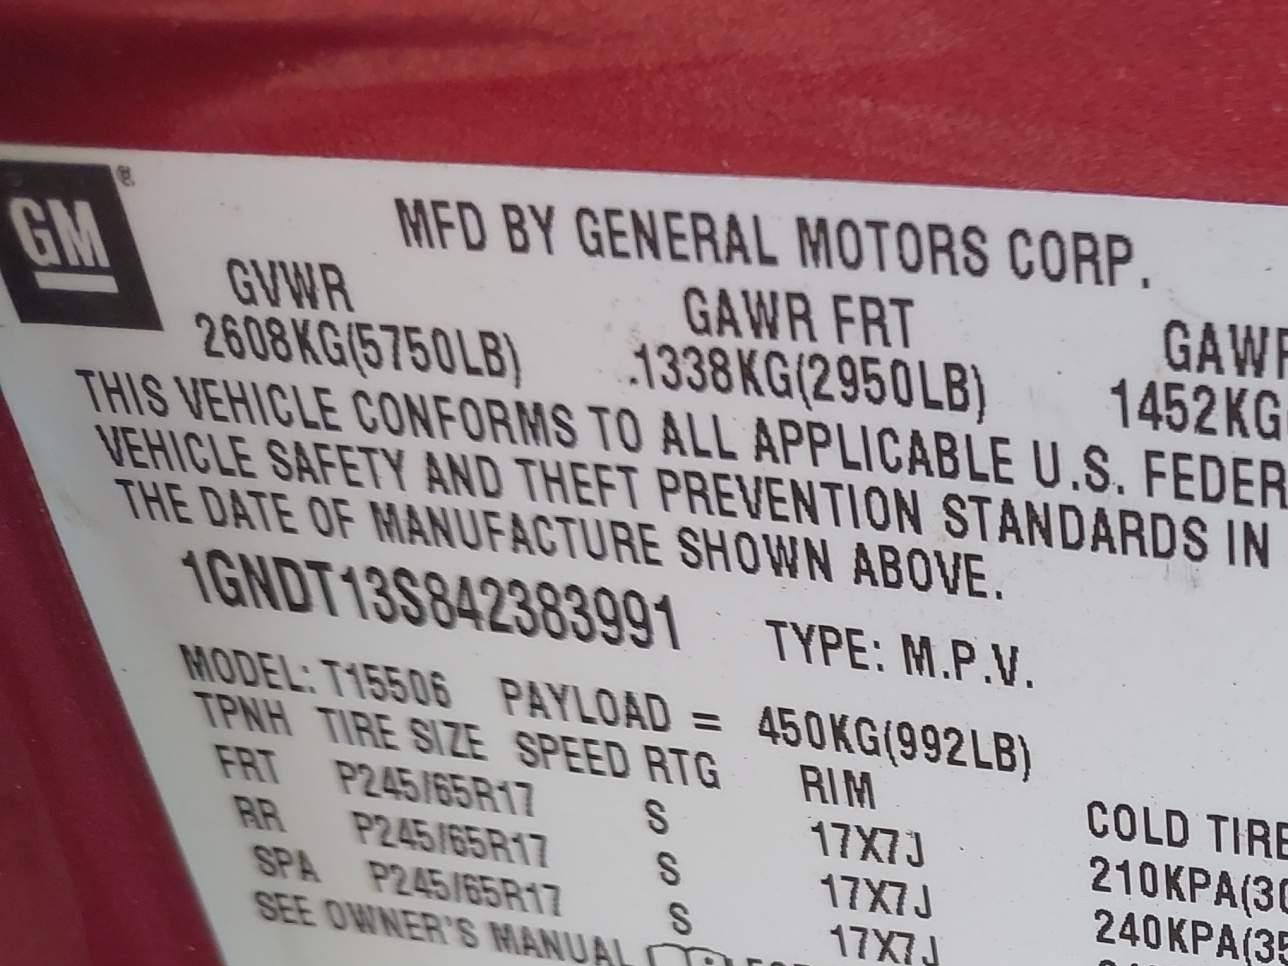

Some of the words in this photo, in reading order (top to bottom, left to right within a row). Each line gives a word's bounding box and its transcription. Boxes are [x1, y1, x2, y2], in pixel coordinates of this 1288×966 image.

[8, 197, 111, 268] GM
[393, 197, 487, 251] MFD
[500, 202, 554, 255] BY
[574, 206, 778, 266] GENERAL
[795, 215, 989, 278] MOTORS
[1007, 227, 1150, 289] CORP.
[225, 257, 354, 312] GVWR
[682, 285, 818, 342] GAWR
[831, 293, 914, 348] FRT
[194, 311, 521, 389] 2608KG(5750LB)
[74, 368, 168, 417] THIS
[172, 375, 342, 431] VEHICLE
[351, 389, 578, 448] CONFORMS
[586, 404, 643, 453] TO
[661, 410, 738, 460] ALL
[753, 416, 1014, 485] APPLICABLE
[1031, 439, 1124, 495] U.S.
[93, 423, 257, 478] VEHICLE
[265, 438, 405, 491] SAFETY
[425, 450, 502, 498] AND
[513, 457, 638, 509] THEFT
[655, 467, 922, 535] PREVENTION
[941, 492, 1208, 563] STANDARDS
[1226, 518, 1269, 569] IN
[113, 477, 193, 524] THE
[198, 485, 298, 534] DATE
[307, 495, 354, 538] OF
[368, 500, 663, 566] MANUFACTURE
[676, 525, 833, 582] SHOWN
[852, 541, 1002, 600] ABOVE.
[180, 548, 680, 650] 1GNDT13S842383991
[177, 643, 315, 693] MODEL:
[319, 658, 451, 708] T15506
[764, 618, 884, 672] TYPE:
[900, 632, 1033, 688] M.P.V.
[192, 690, 292, 735] TPNH
[315, 706, 398, 750] TIRE
[408, 717, 487, 760] SIZE
[498, 677, 671, 732] PAYLOAD
[757, 705, 1031, 783] 450KG(992LB)
[213, 743, 278, 783] FRT
[334, 759, 533, 817] P245/65R17
[513, 730, 630, 778] SPEED
[642, 744, 721, 789] RTG
[798, 763, 876, 809] RIM
[232, 794, 285, 832] RR
[350, 810, 547, 868] P245/65R17
[643, 798, 669, 835] S
[1086, 799, 1189, 848] COLD
[251, 844, 320, 882] SPA
[655, 850, 681, 886] S
[810, 820, 924, 868] 17X7J
[367, 860, 560, 916] P245/65R17
[819, 872, 932, 919] 17X7J
[253, 890, 316, 926] SEE
[323, 899, 478, 948] OWNER'S
[667, 901, 692, 935] S
